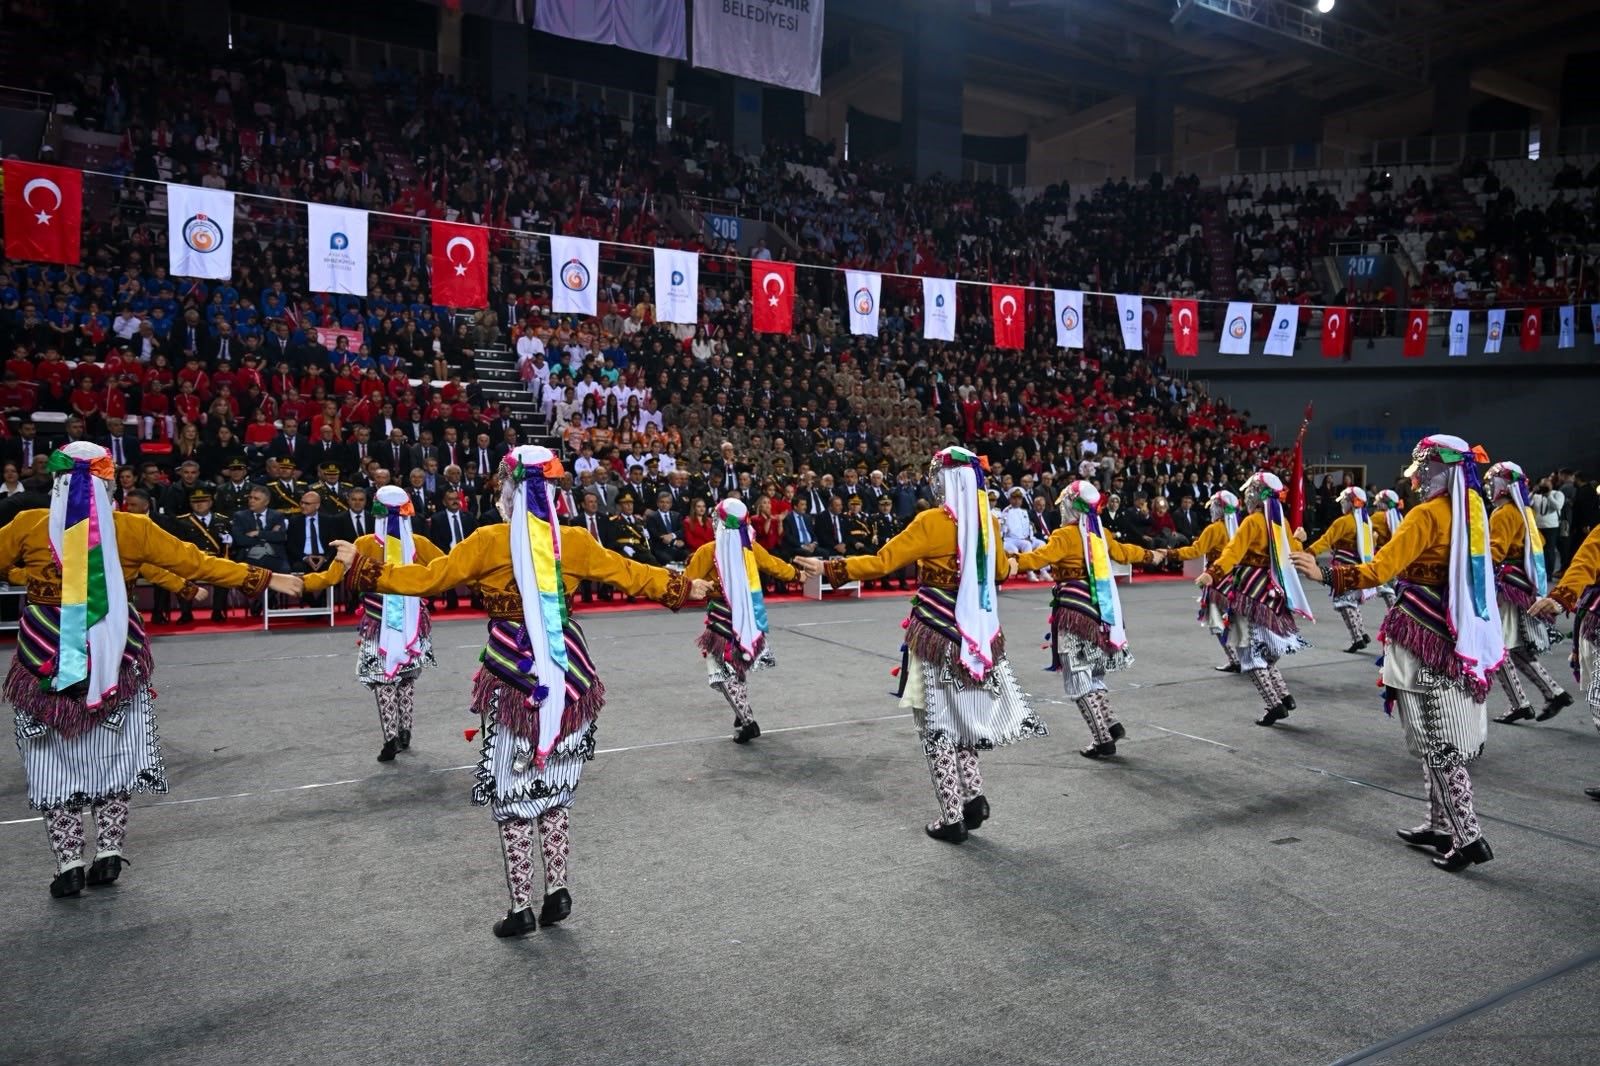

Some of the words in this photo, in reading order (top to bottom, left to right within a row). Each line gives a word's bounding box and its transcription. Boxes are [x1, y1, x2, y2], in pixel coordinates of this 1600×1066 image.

[722, 0, 799, 32] BELEDİYESİ
[713, 217, 738, 240] 206
[1348, 257, 1375, 276] 207
